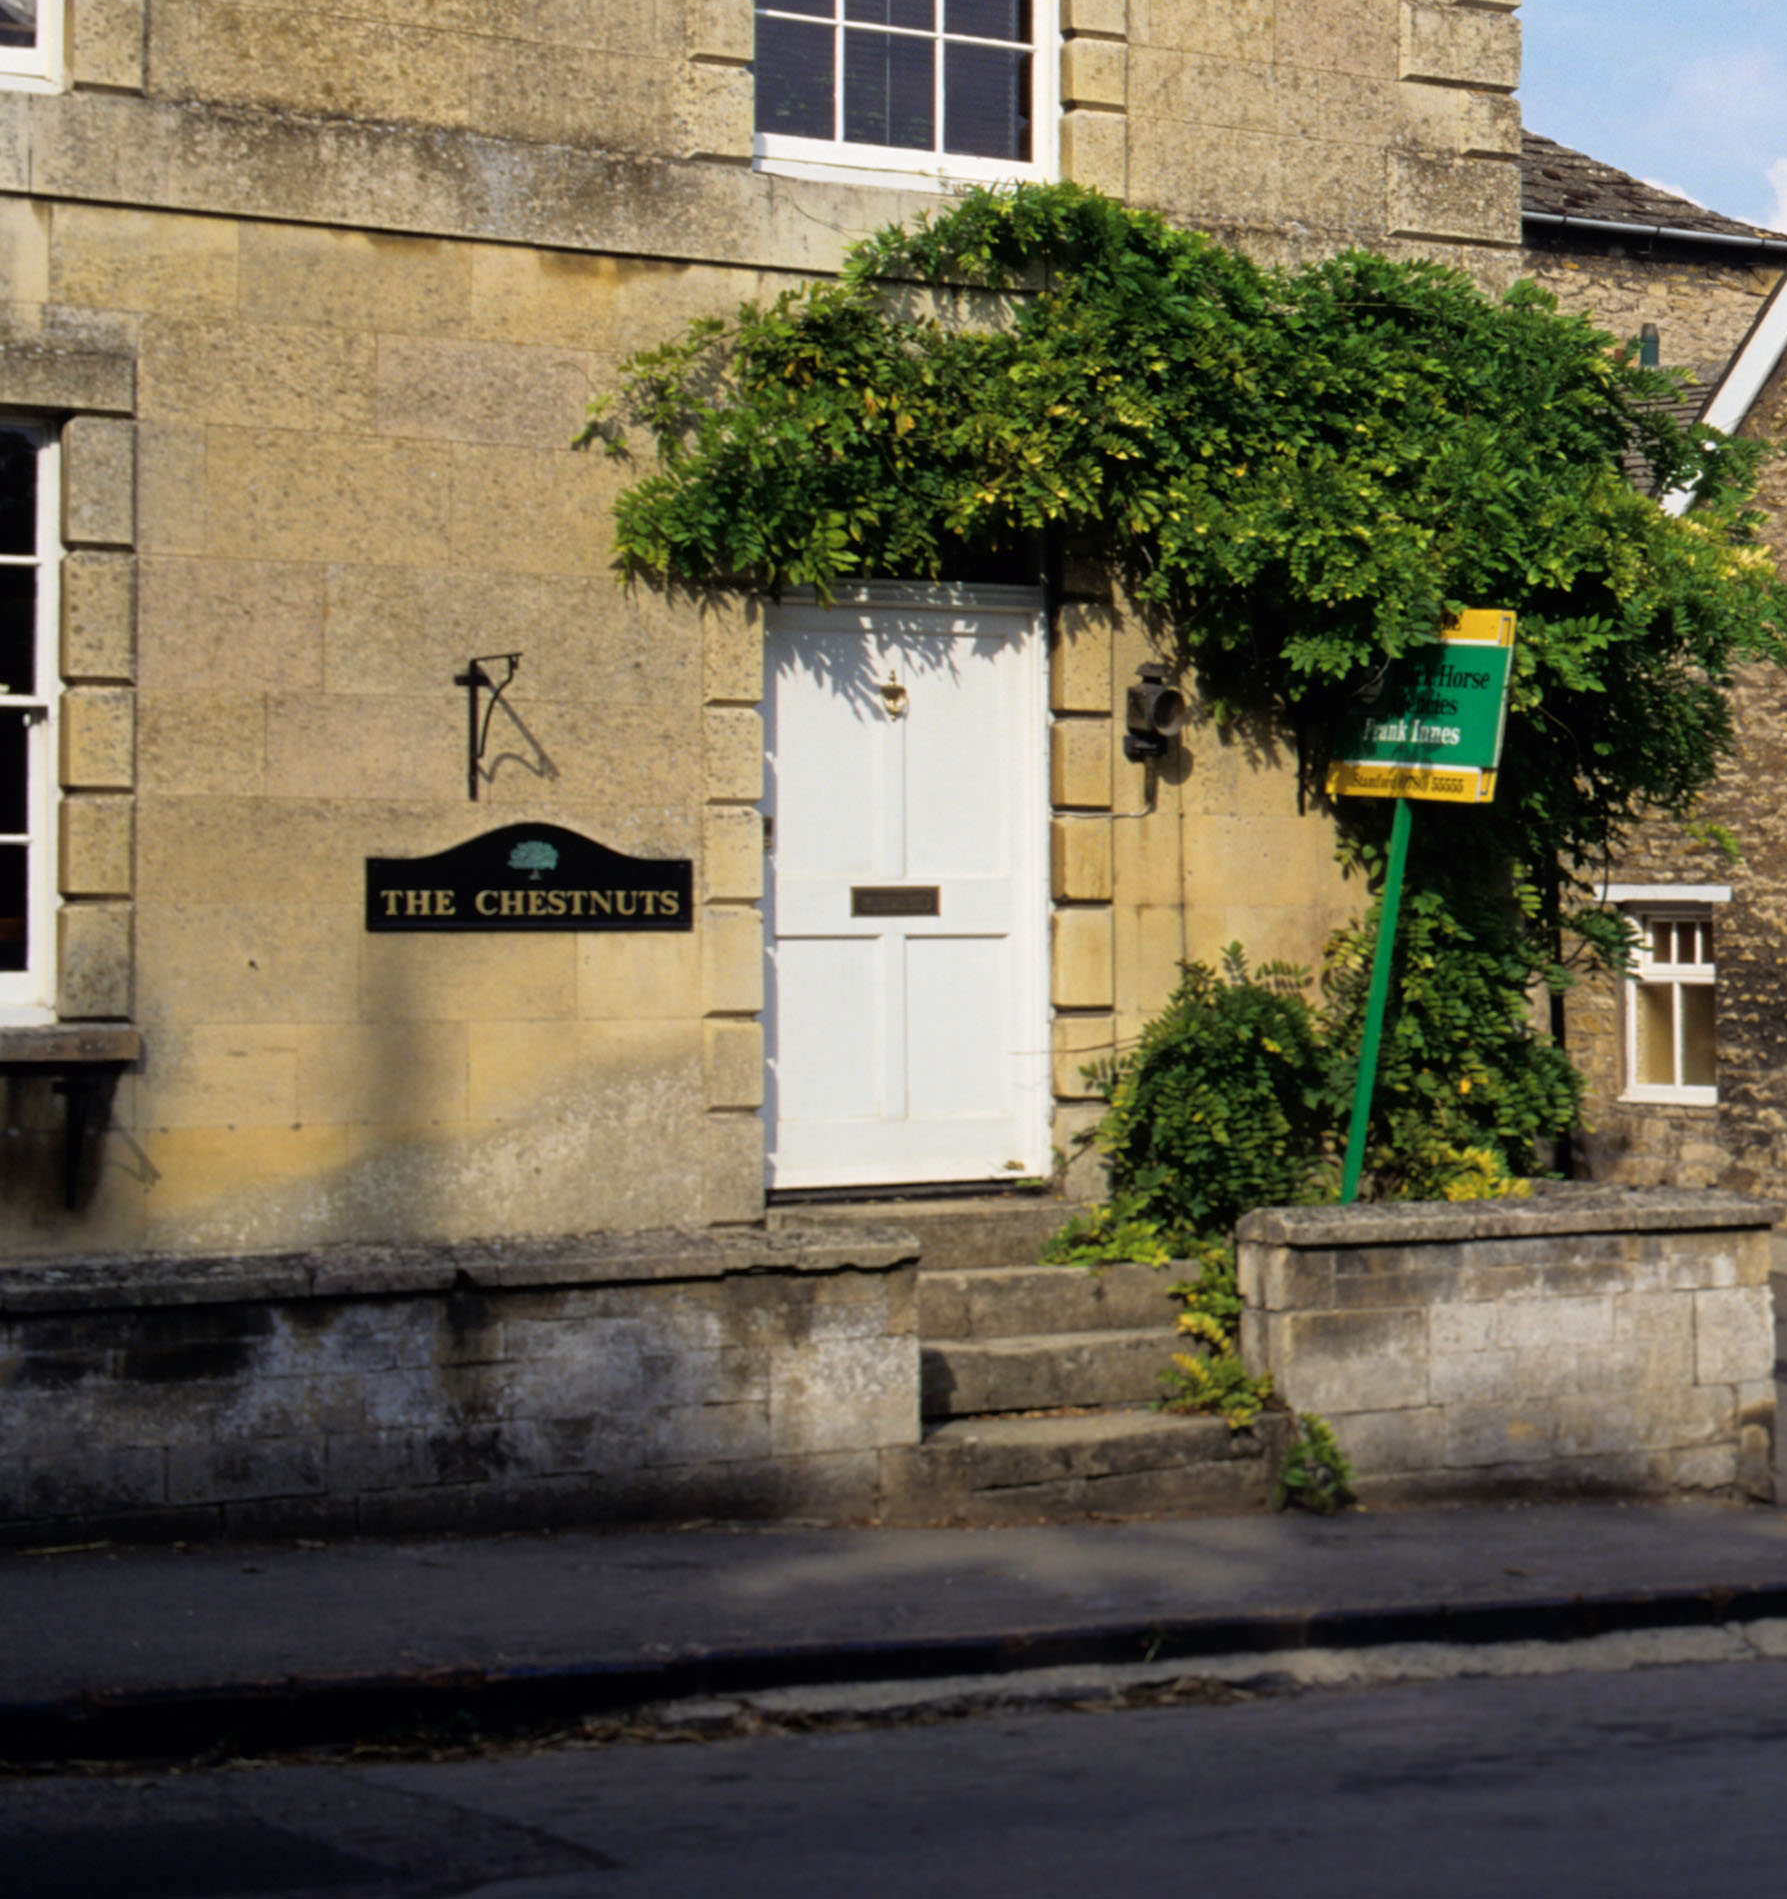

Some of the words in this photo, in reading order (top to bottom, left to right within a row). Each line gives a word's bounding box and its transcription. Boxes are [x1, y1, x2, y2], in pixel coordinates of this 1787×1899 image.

[1438, 664, 1490, 690] Horse
[1385, 691, 1458, 717] gencies
[1363, 718, 1408, 742] Frank
[1410, 719, 1460, 745] Innes
[1430, 776, 1465, 794] 55555
[380, 890, 456, 916] THE
[474, 890, 680, 916] CHESTNUTS
